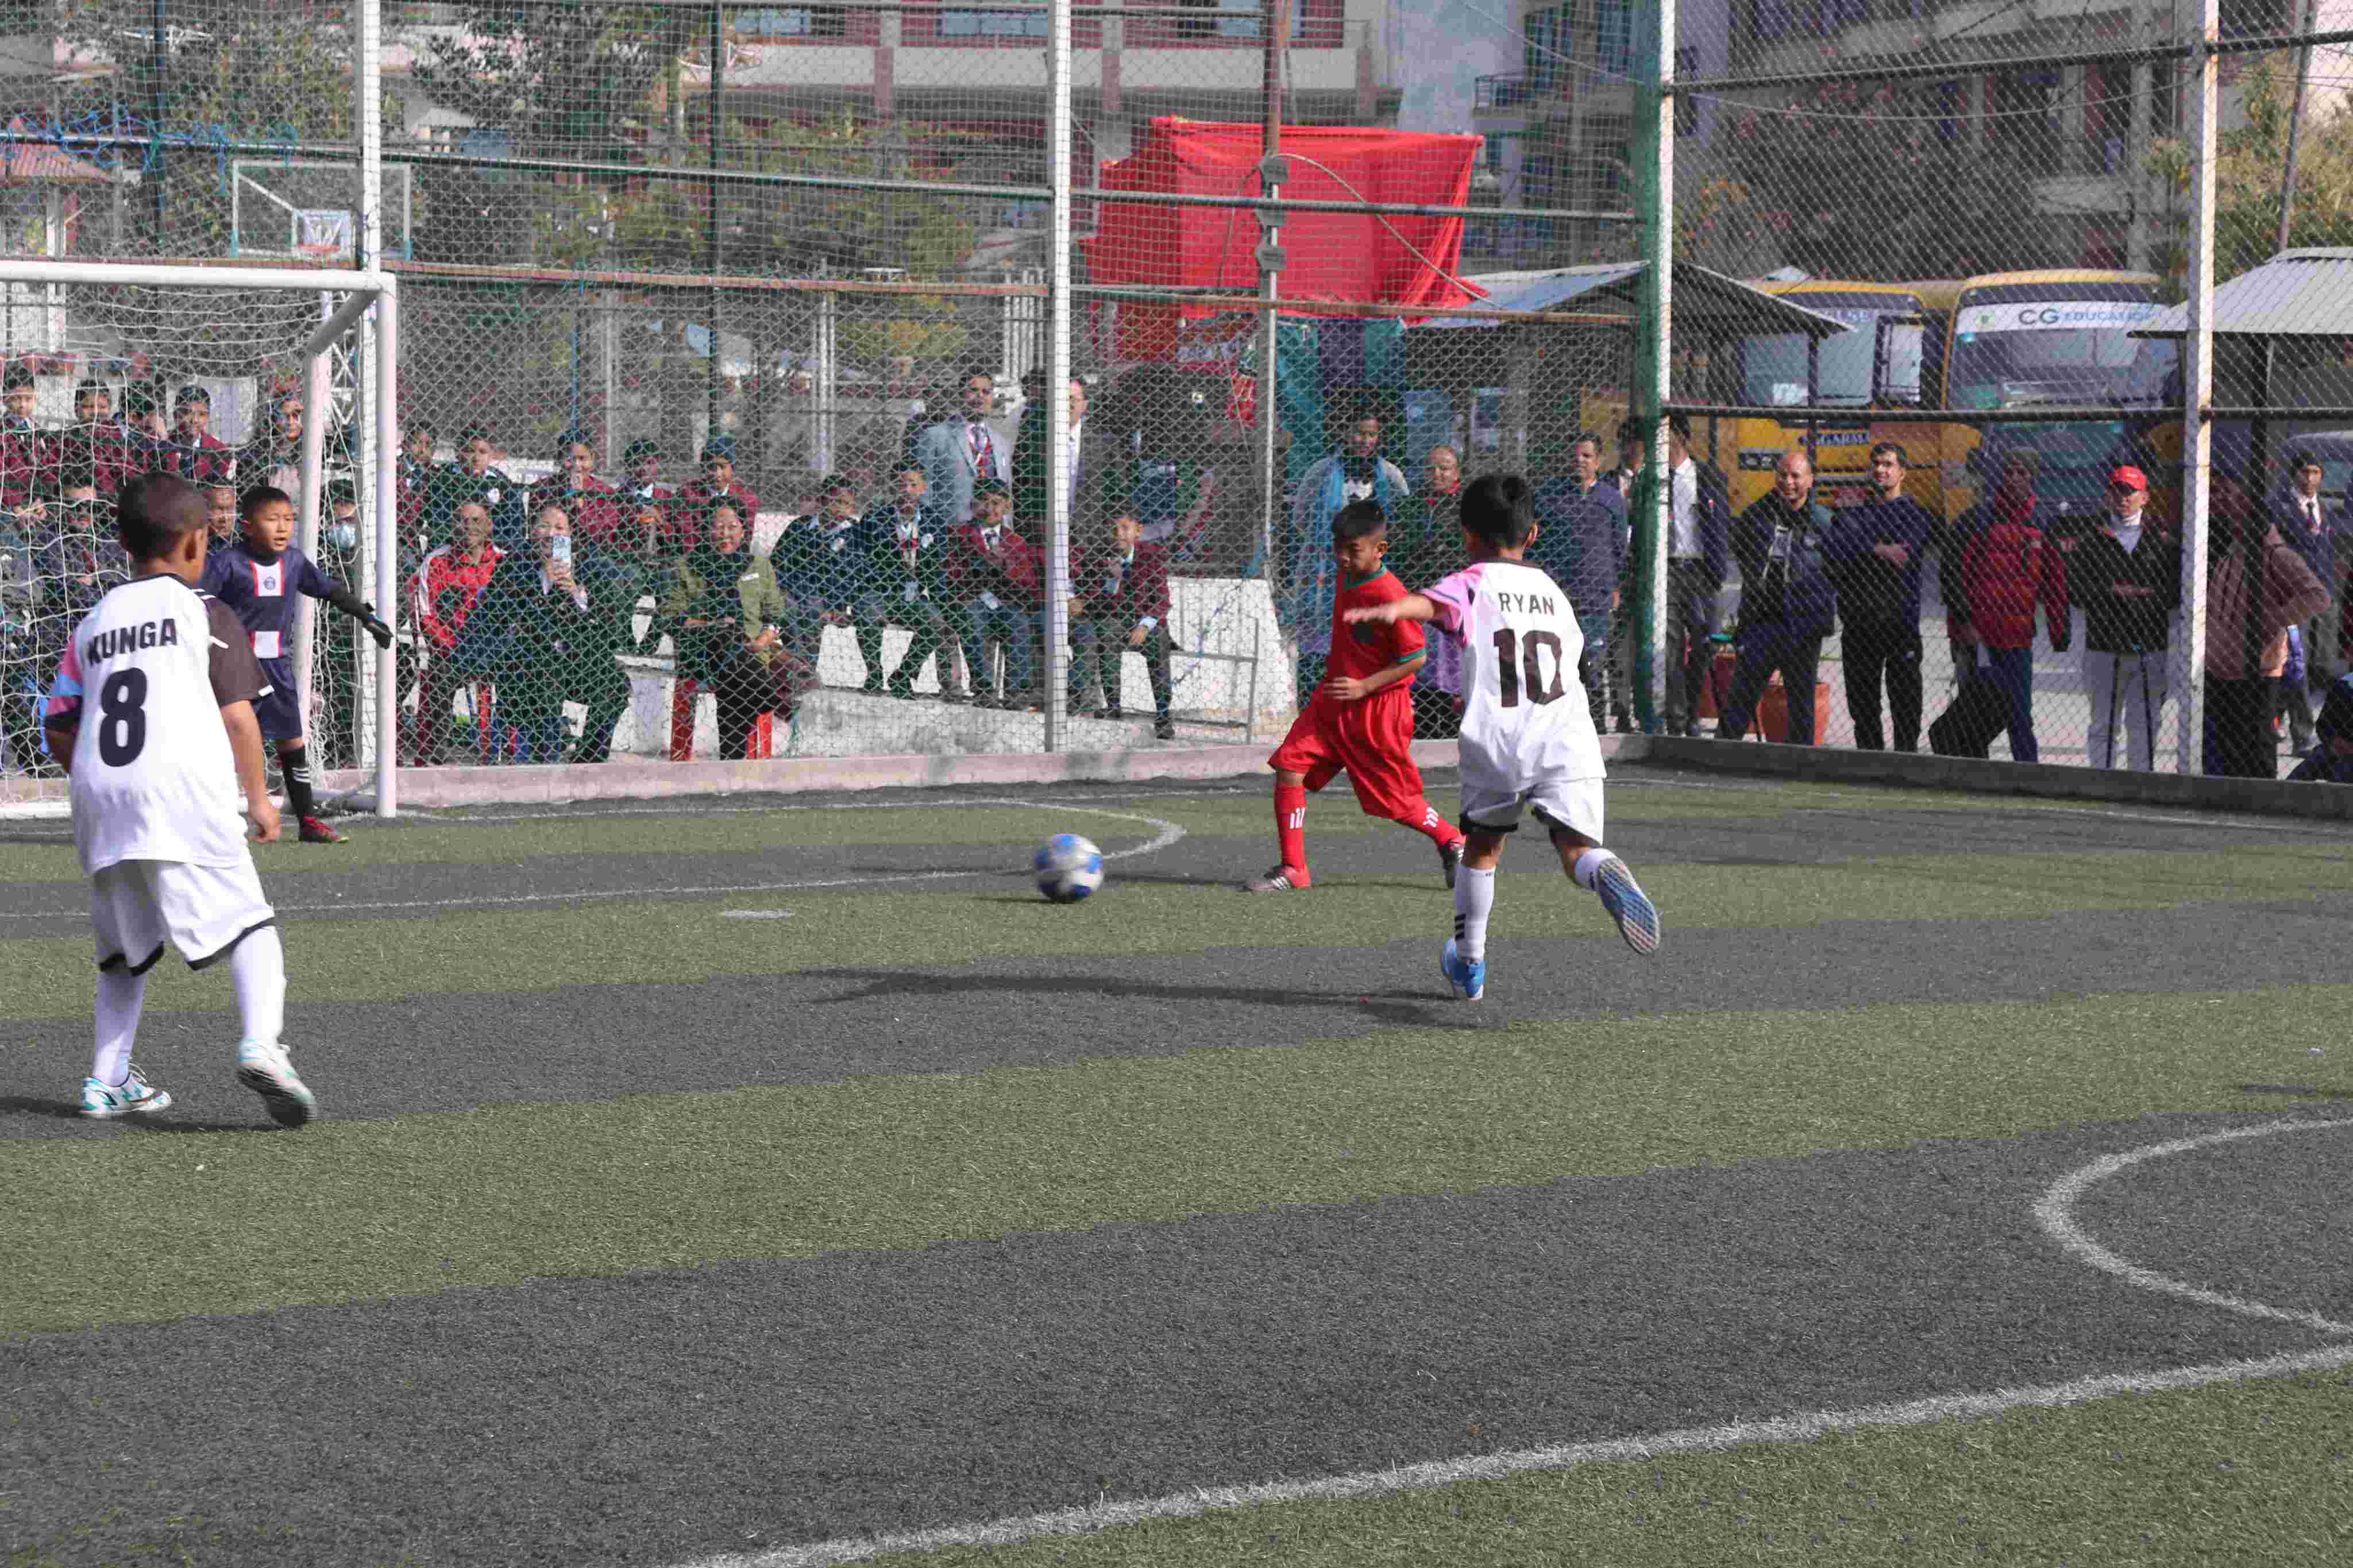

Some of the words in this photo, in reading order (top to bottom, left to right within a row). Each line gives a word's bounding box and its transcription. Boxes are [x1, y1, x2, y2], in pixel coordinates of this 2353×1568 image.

[2019, 309, 2059, 325] CG
[1498, 592, 1554, 616] RYAN
[88, 619, 177, 667] KUNGA
[1494, 628, 1565, 707] 10
[99, 667, 147, 767] 8
